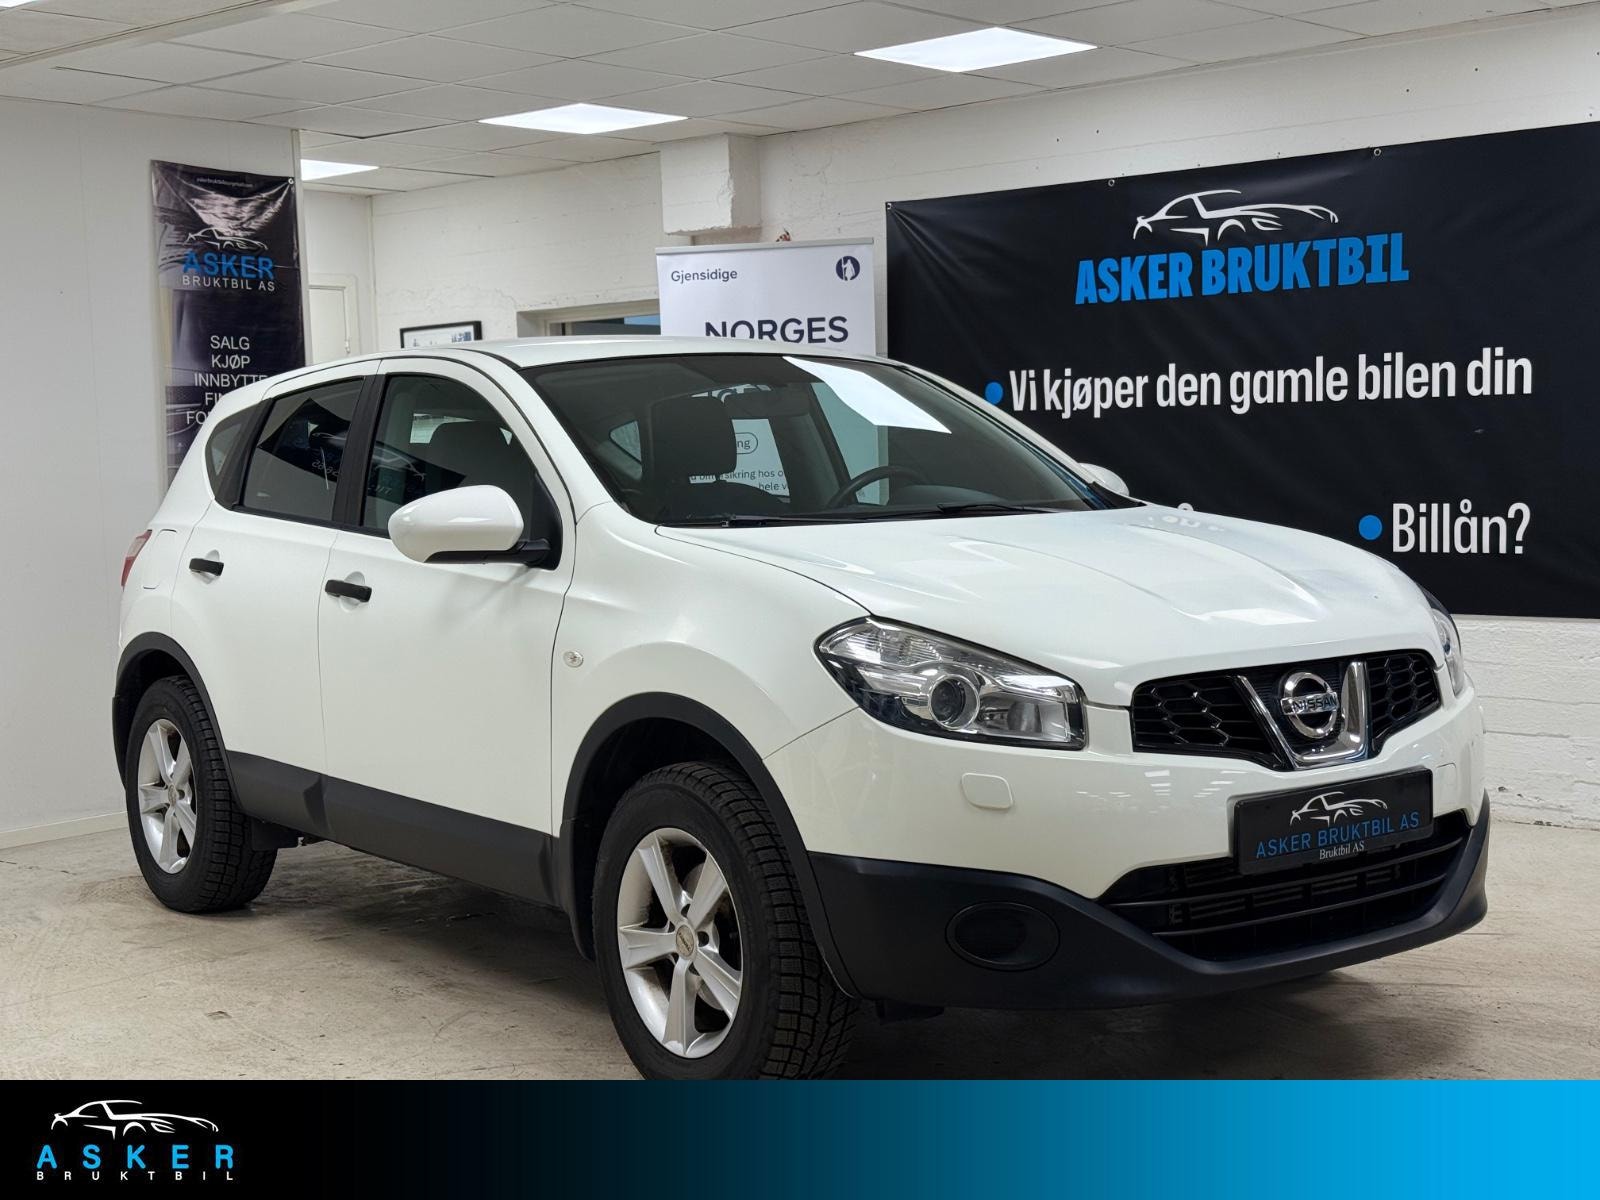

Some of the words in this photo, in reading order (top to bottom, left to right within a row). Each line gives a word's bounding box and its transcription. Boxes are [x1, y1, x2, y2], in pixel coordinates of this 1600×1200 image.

[183, 248, 274, 280] ASKER
[671, 268, 738, 284] Gjensidige
[1075, 251, 1193, 305] ASKER
[1200, 232, 1410, 296] BRUKTBIL
[182, 275, 252, 290] BRUKTBIL
[258, 281, 275, 292] AS
[705, 316, 849, 344] NORGES
[210, 335, 250, 350] SALG
[211, 354, 250, 369] KJØP
[1009, 369, 1037, 411] Vi
[1043, 368, 1148, 419] kjøper
[1156, 363, 1221, 407] den
[1229, 355, 1348, 415] gamle
[1358, 351, 1456, 400] bilen
[1466, 346, 1532, 396] din
[1392, 498, 1531, 554] Billån?
[1292, 693, 1337, 710] NISSAN
[1256, 832, 1311, 859] ASKER
[1317, 817, 1395, 847] BRUKTBIL
[1400, 811, 1420, 829] AS
[1319, 843, 1351, 860] Bruktbil
[1352, 840, 1365, 853] AS
